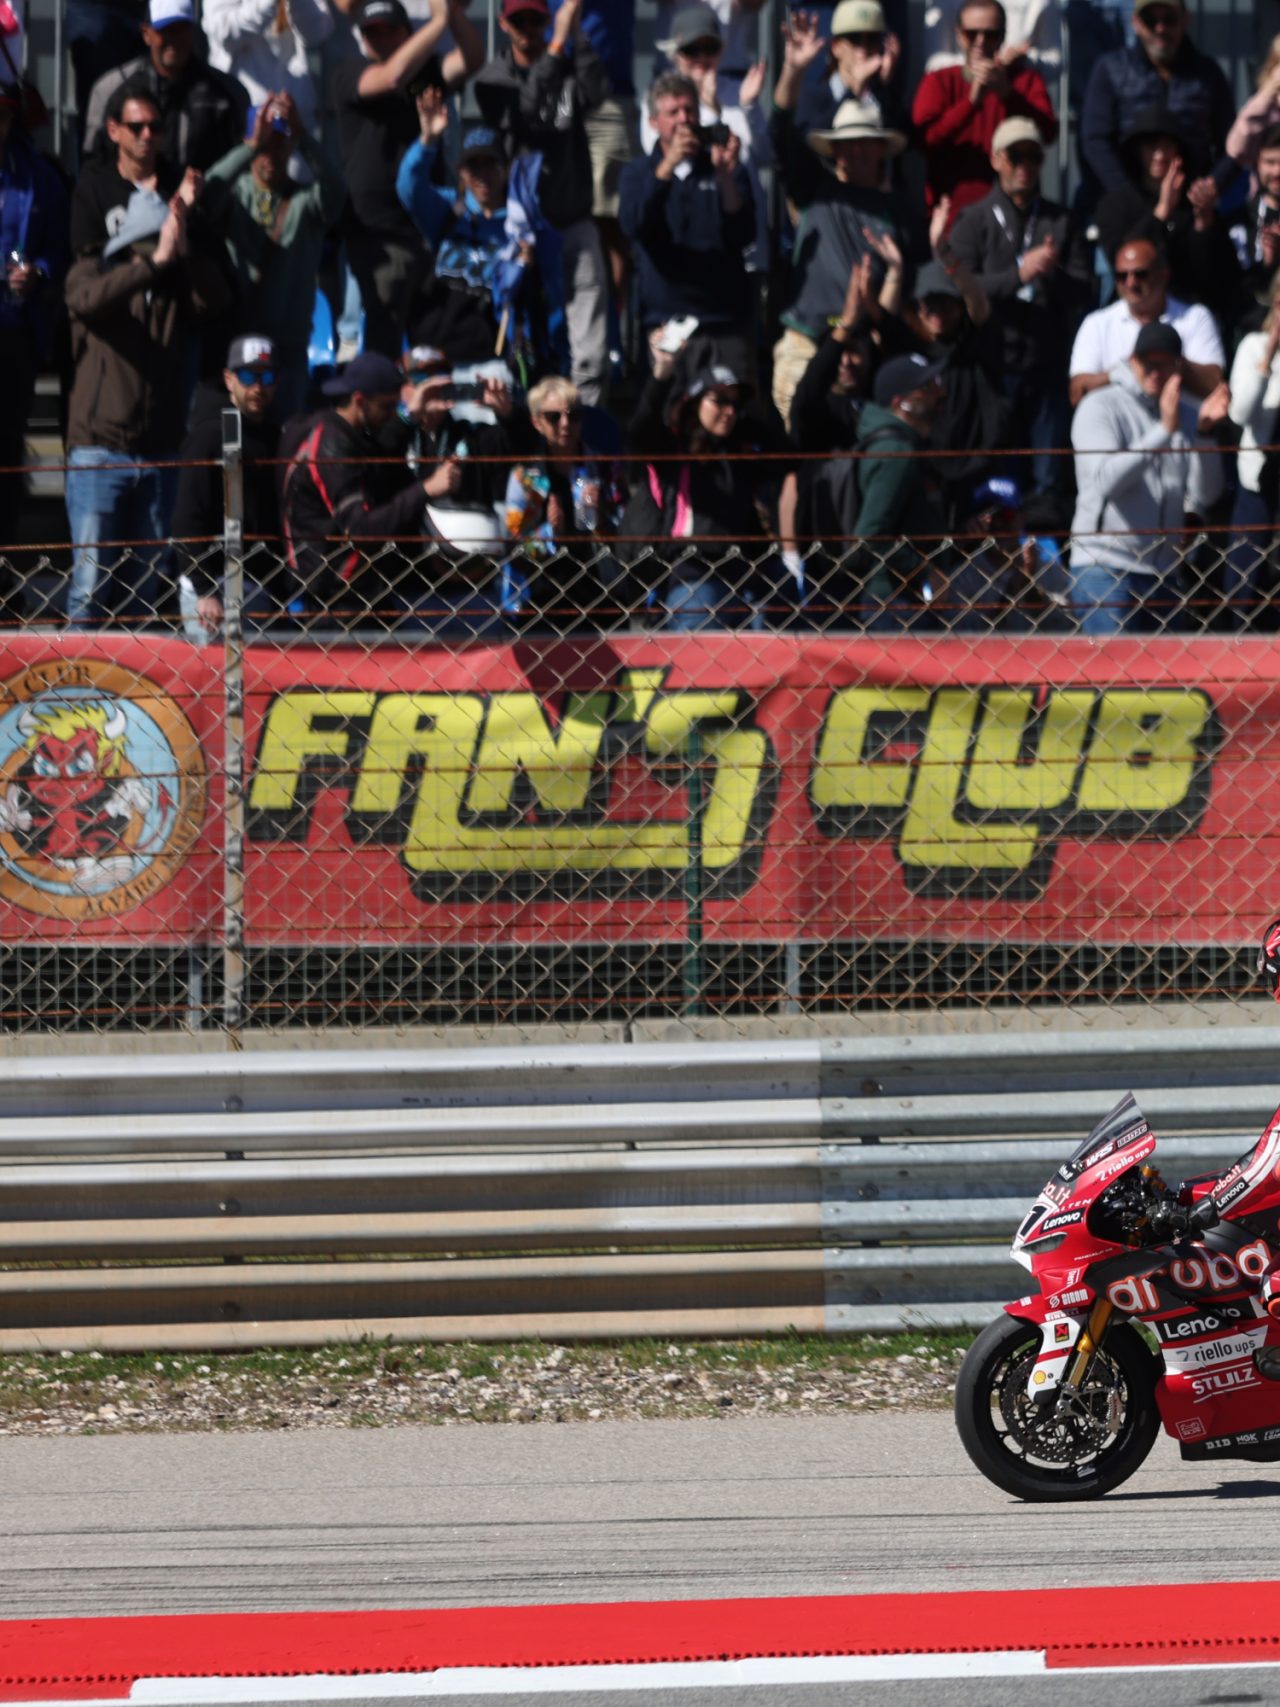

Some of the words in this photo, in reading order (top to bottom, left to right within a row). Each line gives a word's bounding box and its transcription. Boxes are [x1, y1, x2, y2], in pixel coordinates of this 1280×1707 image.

[247, 664, 776, 900] FAN'S
[807, 684, 1222, 897] CLUB
[1108, 1154, 1134, 1175] riello
[1134, 1147, 1150, 1160] ups
[1216, 1181, 1246, 1208] Lenovo
[1043, 1212, 1082, 1231] Lenovo
[1163, 1307, 1242, 1339] Lenovo
[1194, 1341, 1233, 1362] riello
[1235, 1339, 1256, 1355] ups
[1191, 1368, 1256, 1395] STULZ
